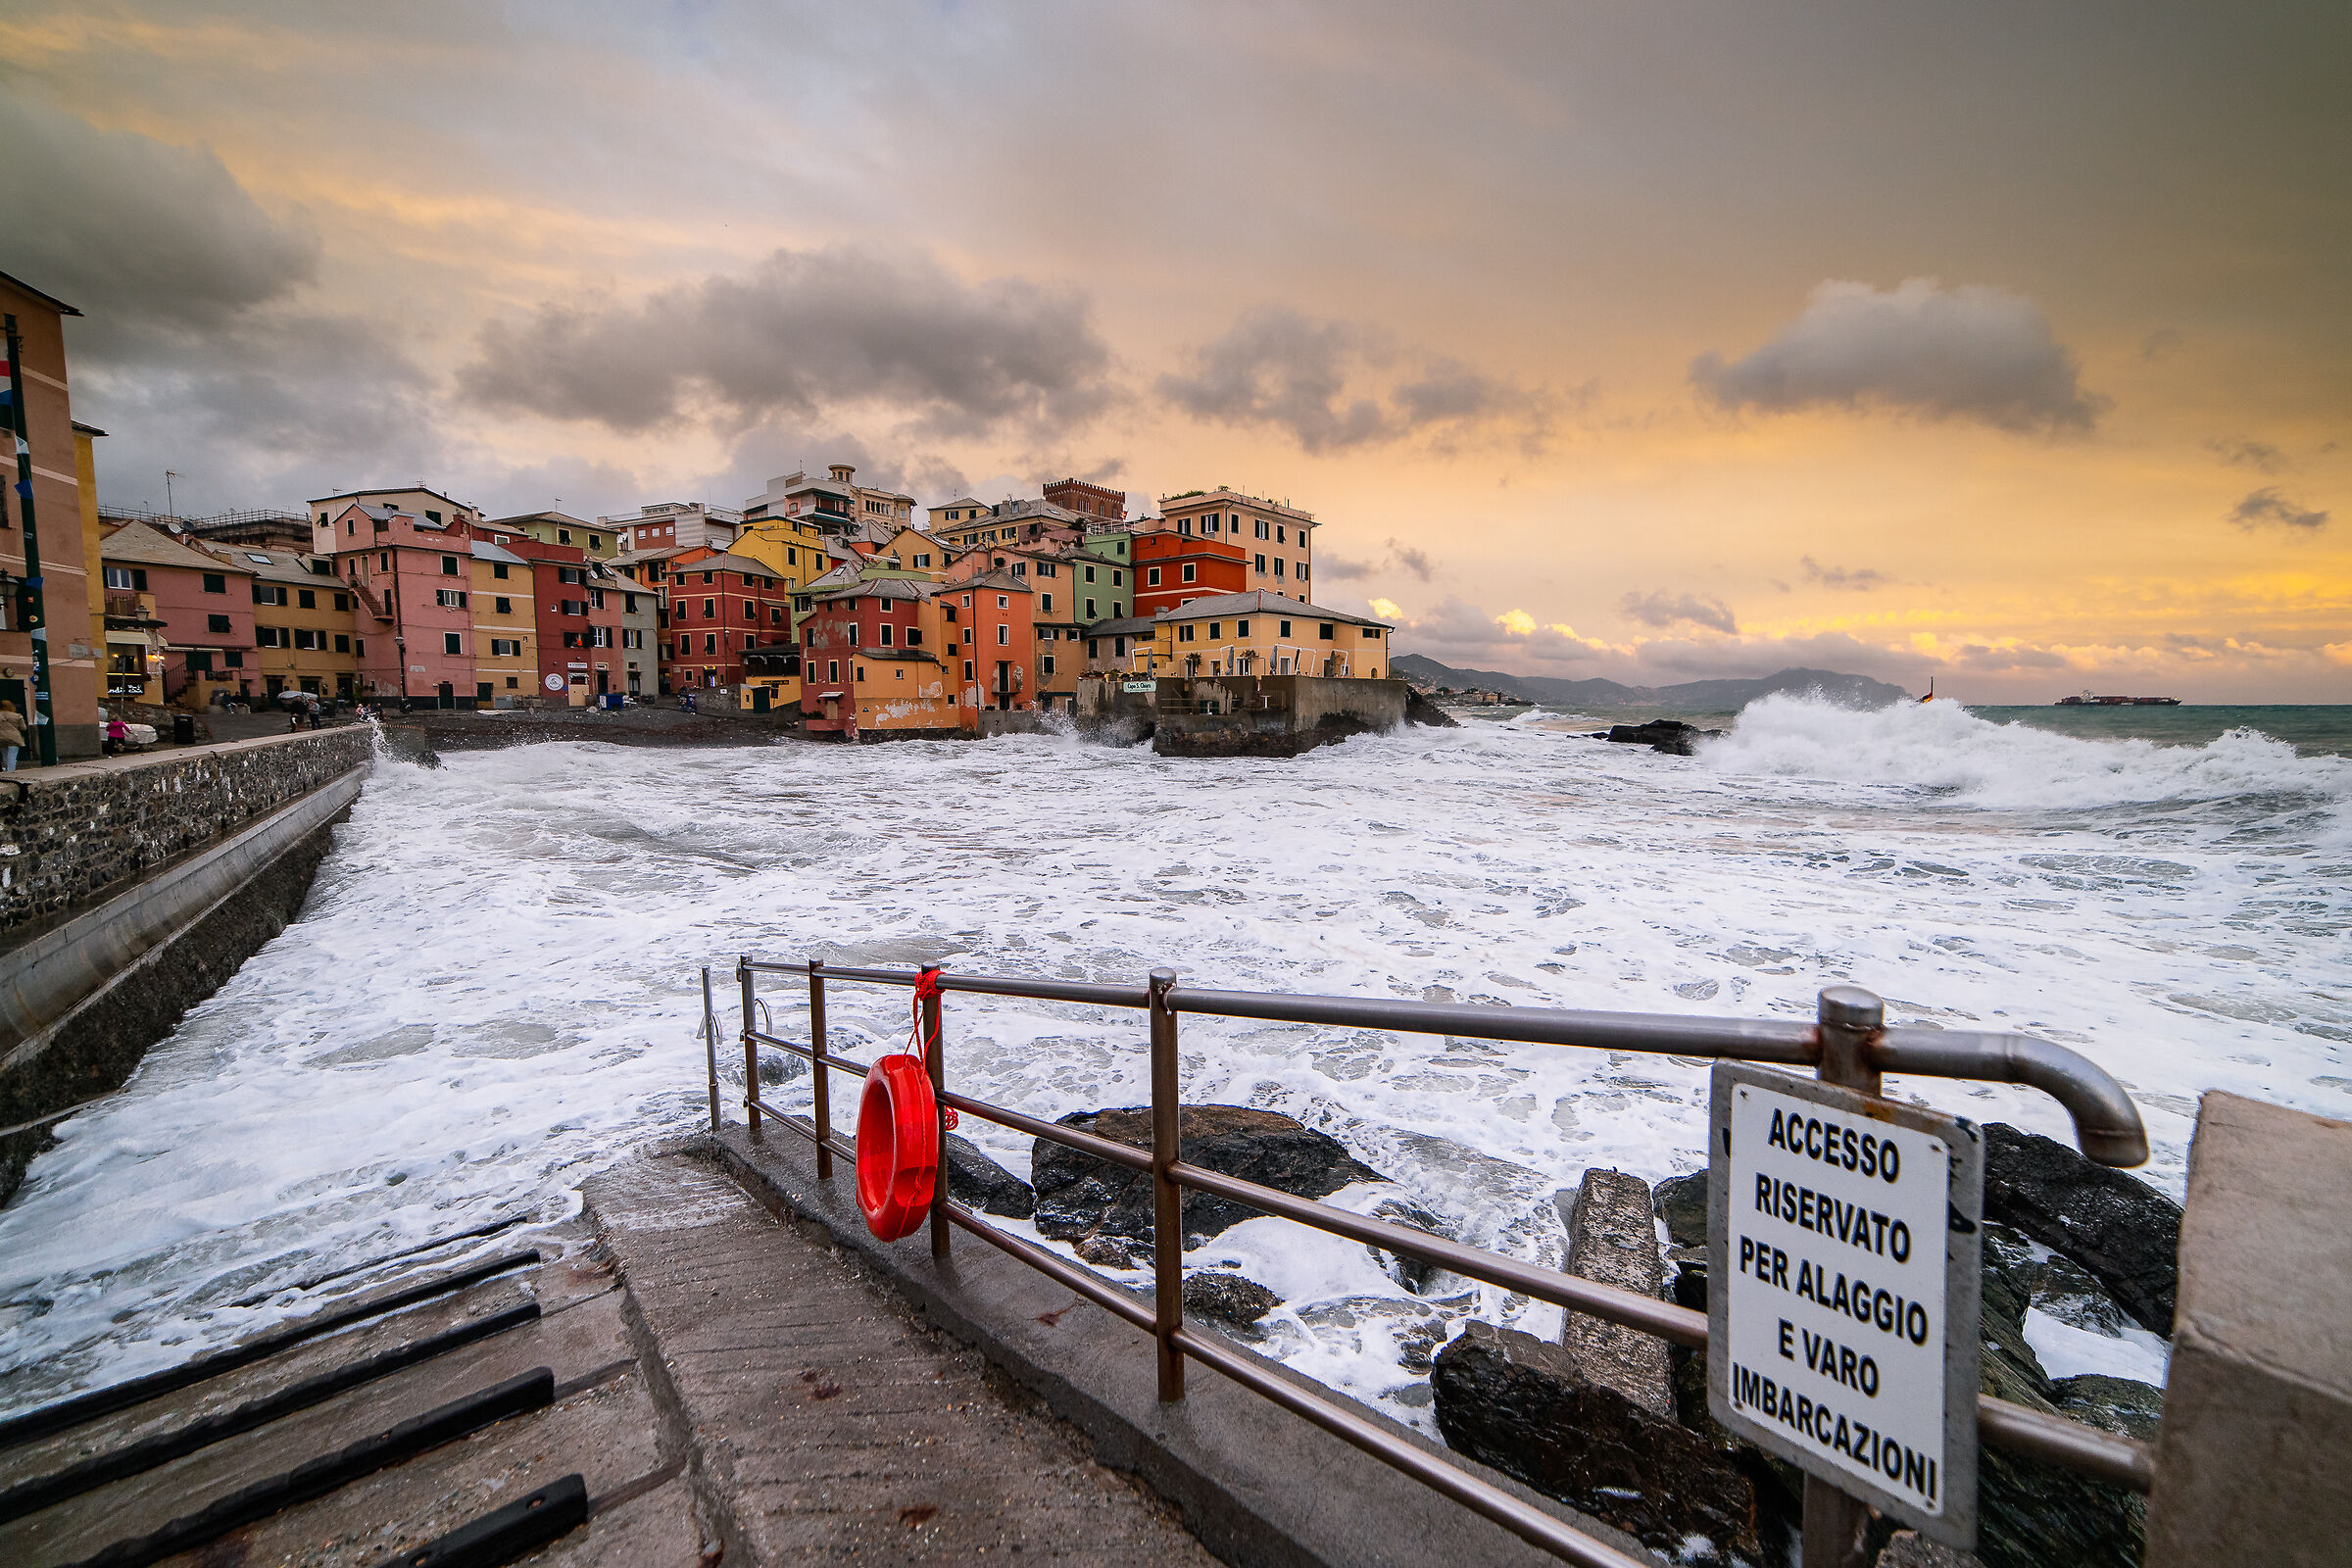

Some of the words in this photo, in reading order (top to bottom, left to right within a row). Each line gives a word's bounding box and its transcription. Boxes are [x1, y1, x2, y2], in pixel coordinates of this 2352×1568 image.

[1767, 1107, 1900, 1184] ACCESSO
[1754, 1172, 1911, 1264] RISERVATO
[1740, 1234, 1789, 1292] PER
[1795, 1258, 1929, 1347] ALAGGIO
[1778, 1318, 1794, 1362] E
[1801, 1327, 1880, 1398] VARO
[1733, 1361, 1936, 1501] IMBARCAZIONI
